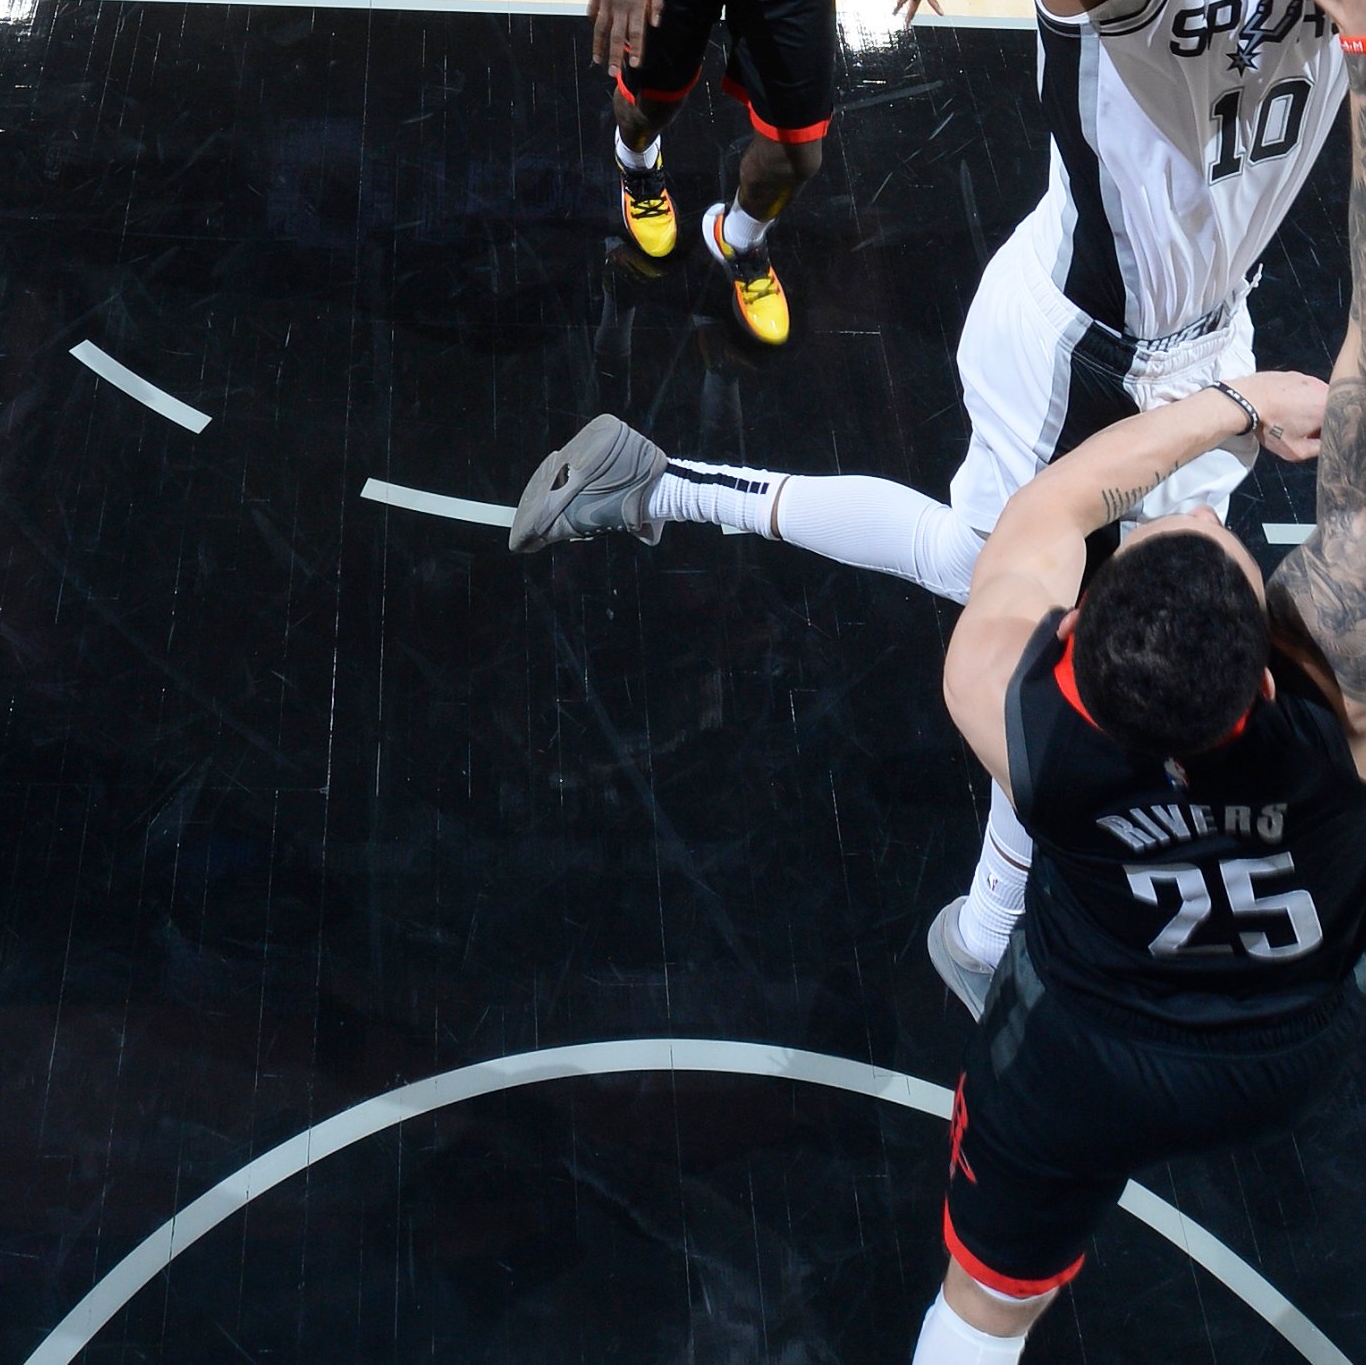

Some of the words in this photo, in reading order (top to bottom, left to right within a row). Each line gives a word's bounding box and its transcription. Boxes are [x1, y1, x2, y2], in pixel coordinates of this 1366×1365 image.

[1209, 78, 1315, 187] 10
[1096, 803, 1288, 851] RIVERS
[1122, 851, 1323, 959] 25
